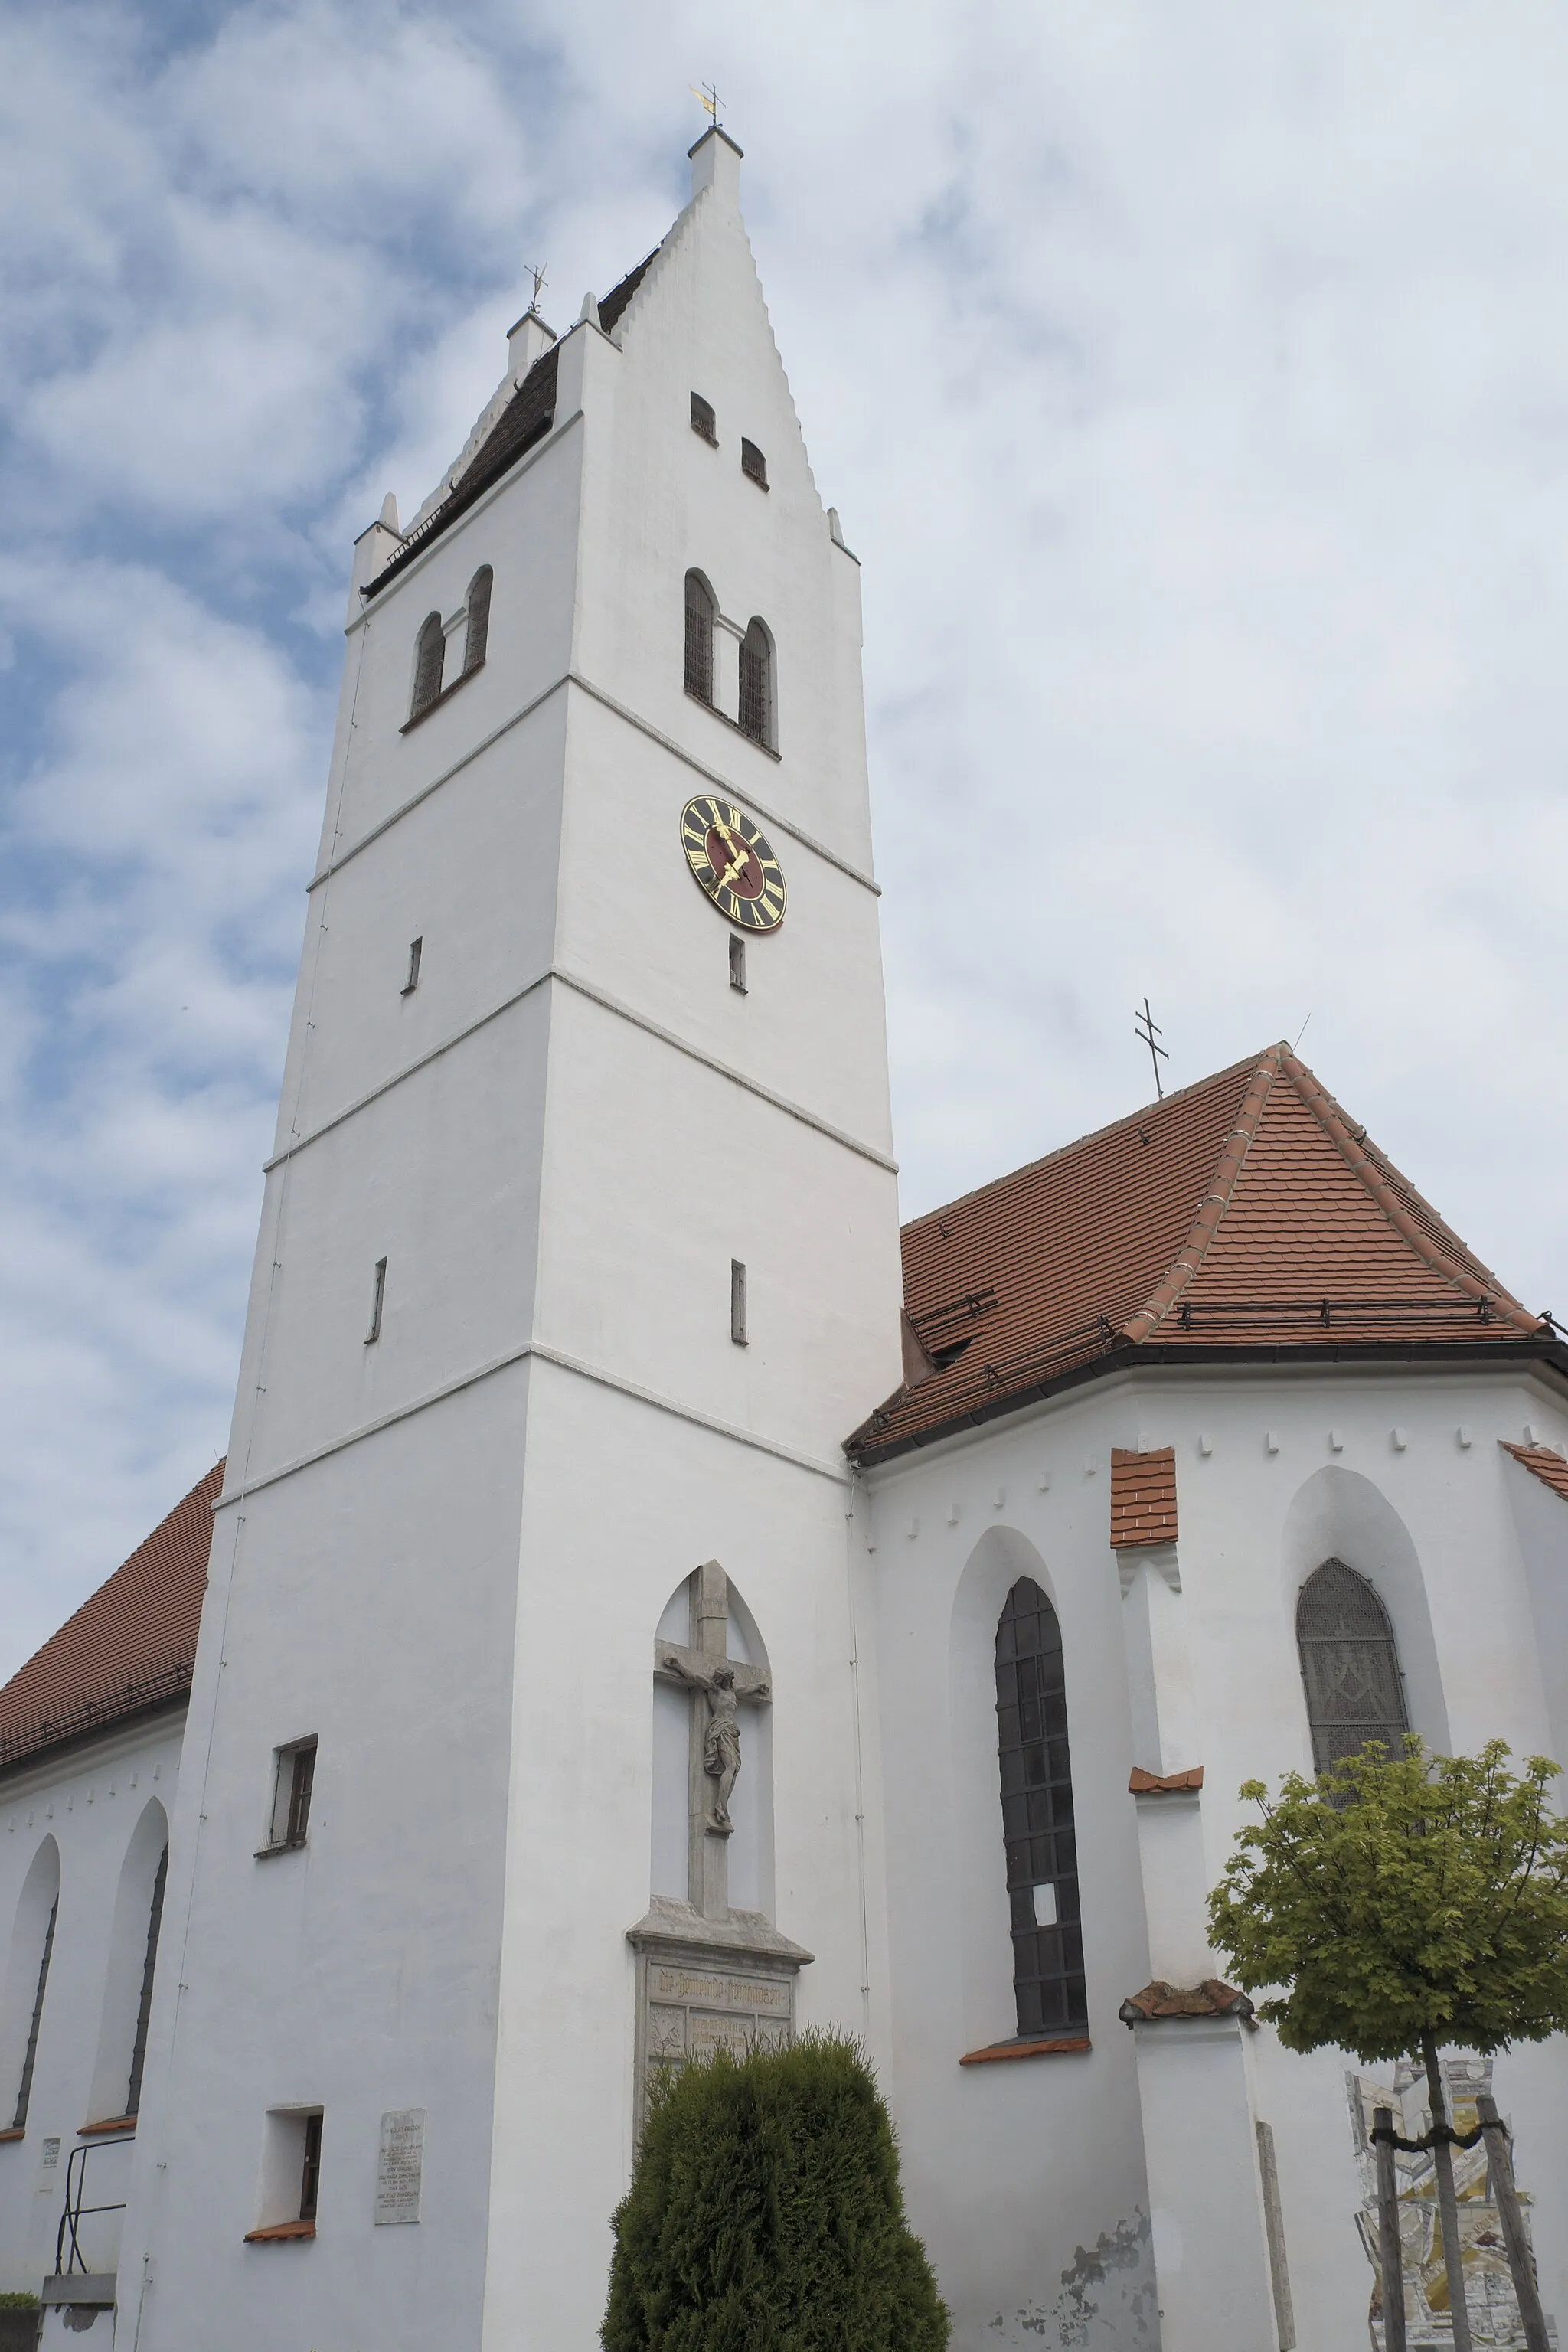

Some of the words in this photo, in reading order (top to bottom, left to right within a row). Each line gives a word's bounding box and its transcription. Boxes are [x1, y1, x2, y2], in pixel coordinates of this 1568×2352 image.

[690, 804, 709, 828] X
[748, 831, 762, 845] I
[730, 893, 742, 920] VI
[750, 902, 765, 926] V
